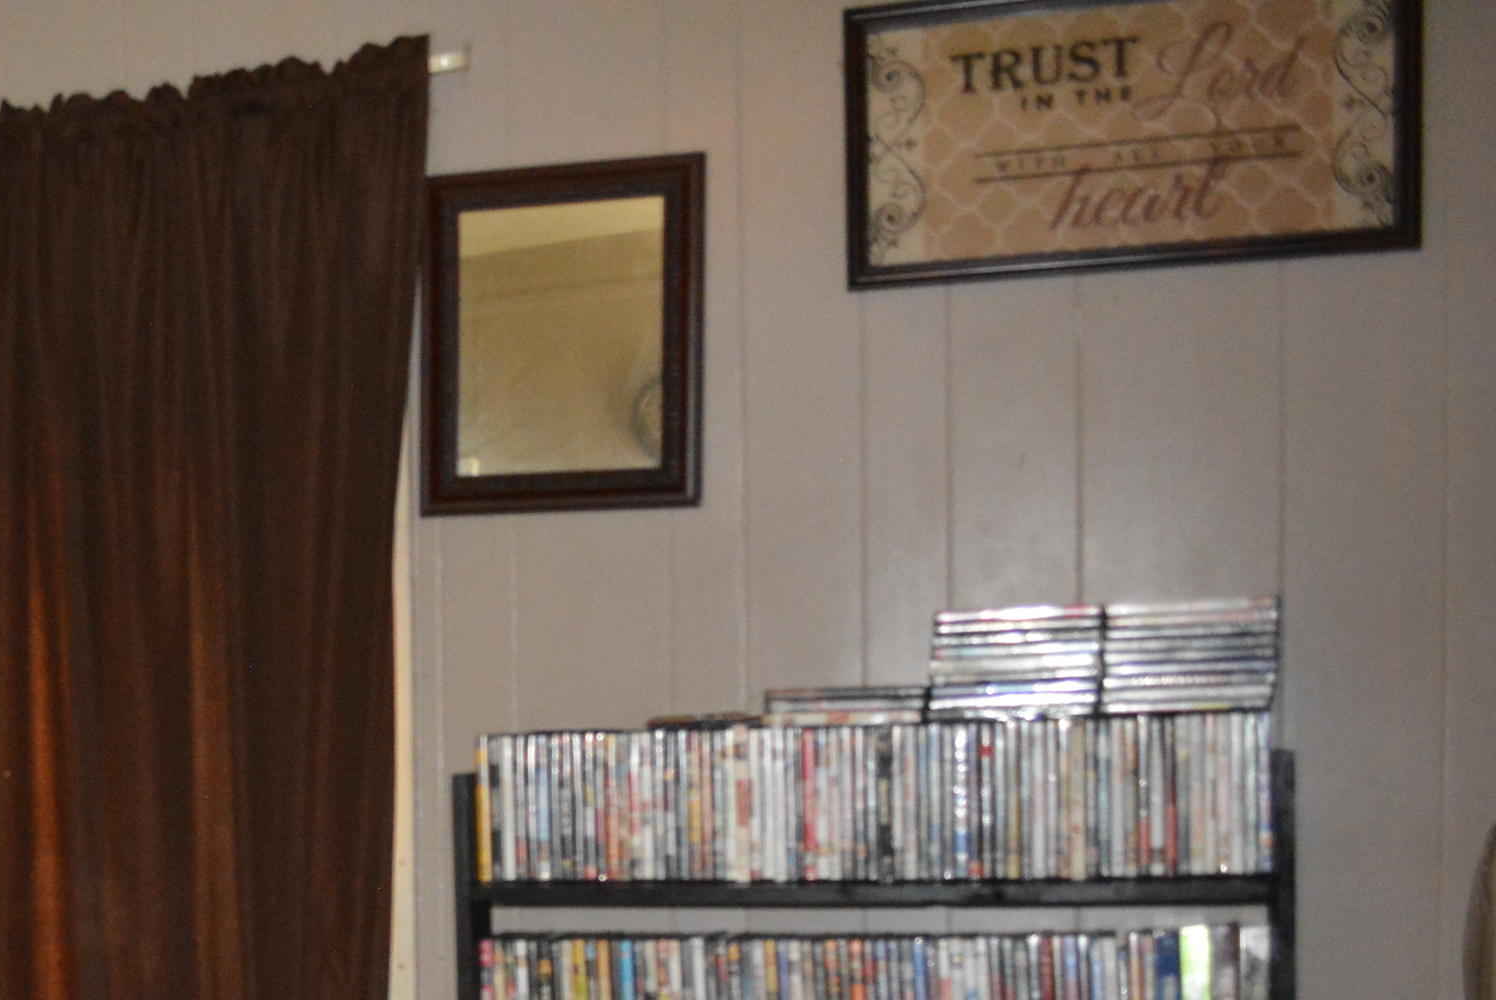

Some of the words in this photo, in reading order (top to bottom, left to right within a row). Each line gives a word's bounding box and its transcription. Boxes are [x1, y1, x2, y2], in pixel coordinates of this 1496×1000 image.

[949, 35, 1140, 95] TRUST
[1132, 20, 1306, 126] Lord
[1020, 94, 1054, 112] IN
[1074, 85, 1133, 106] THE
[1051, 159, 1223, 231] heart
